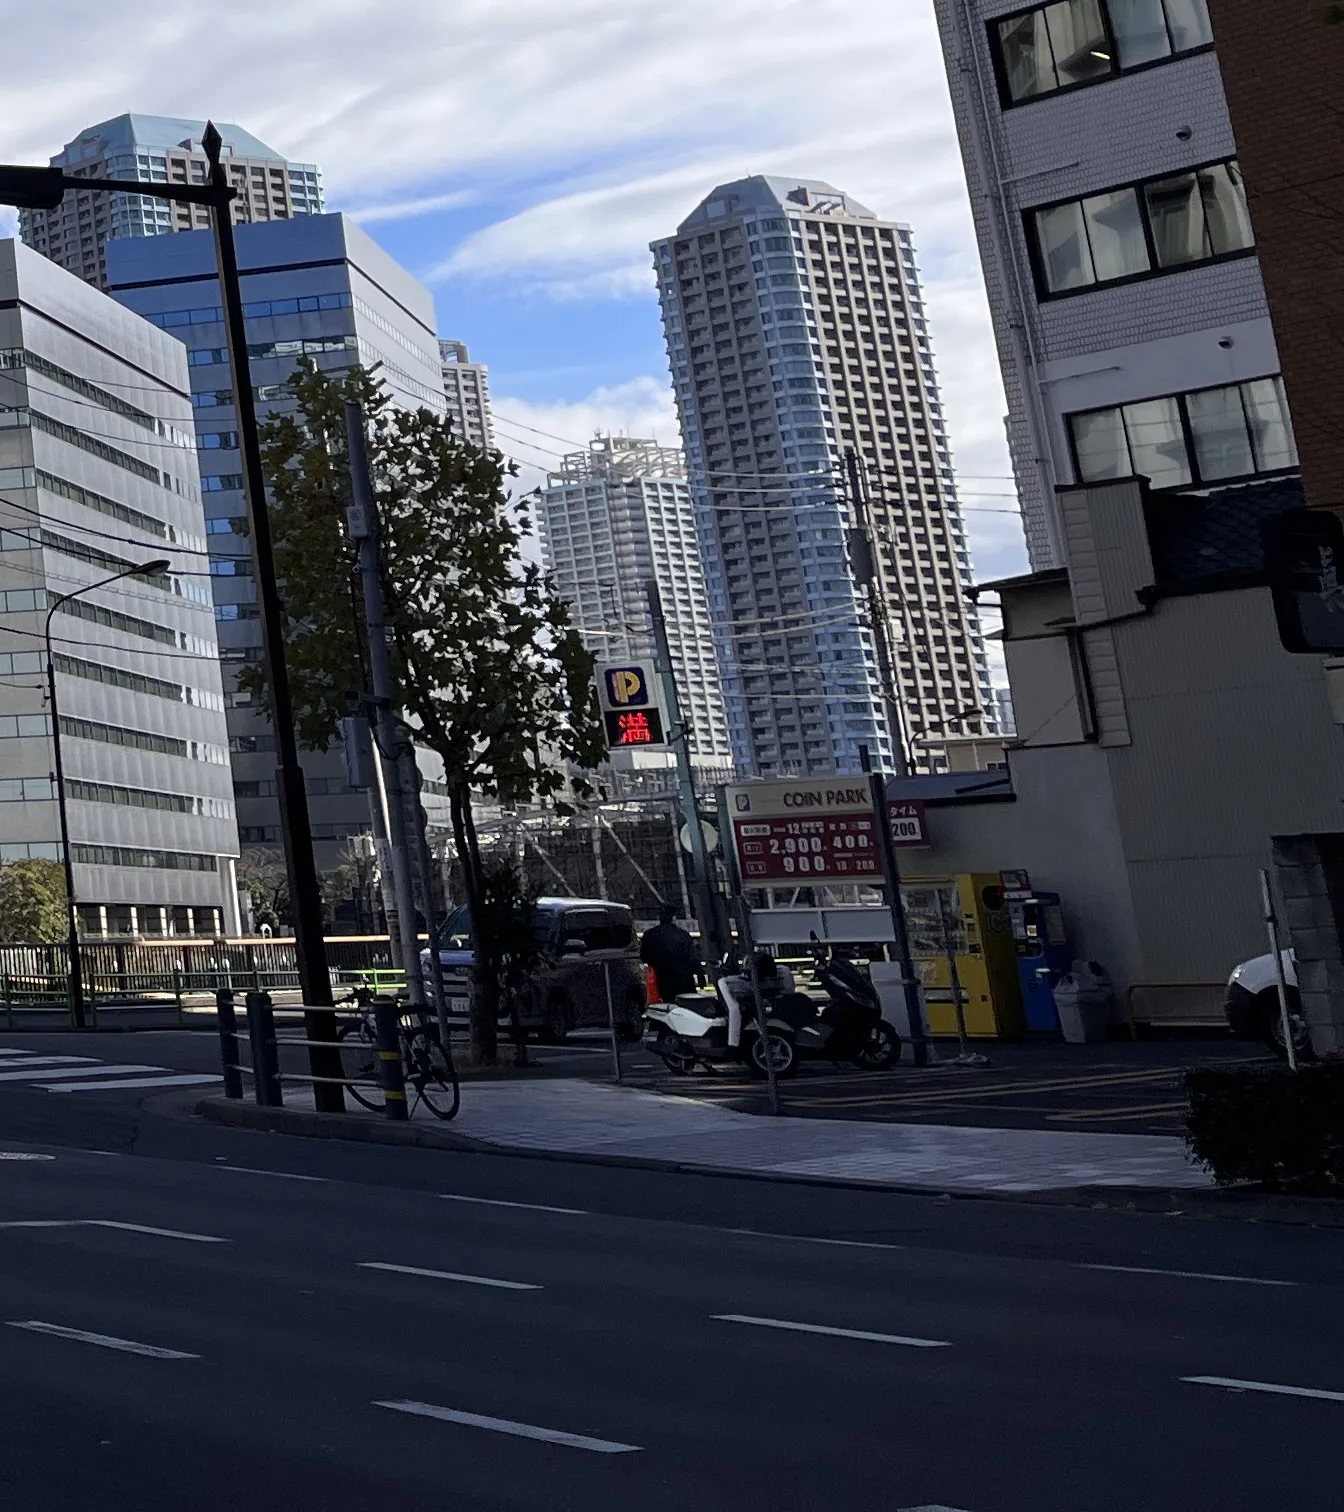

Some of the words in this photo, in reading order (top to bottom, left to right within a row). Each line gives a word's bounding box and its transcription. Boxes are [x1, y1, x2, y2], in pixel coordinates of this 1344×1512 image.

[611, 670, 641, 703] P
[618, 712, 652, 744] 満
[783, 791, 823, 807] COIN
[826, 788, 869, 805] PARK
[892, 822, 916, 836] 200
[832, 834, 869, 849] 400
